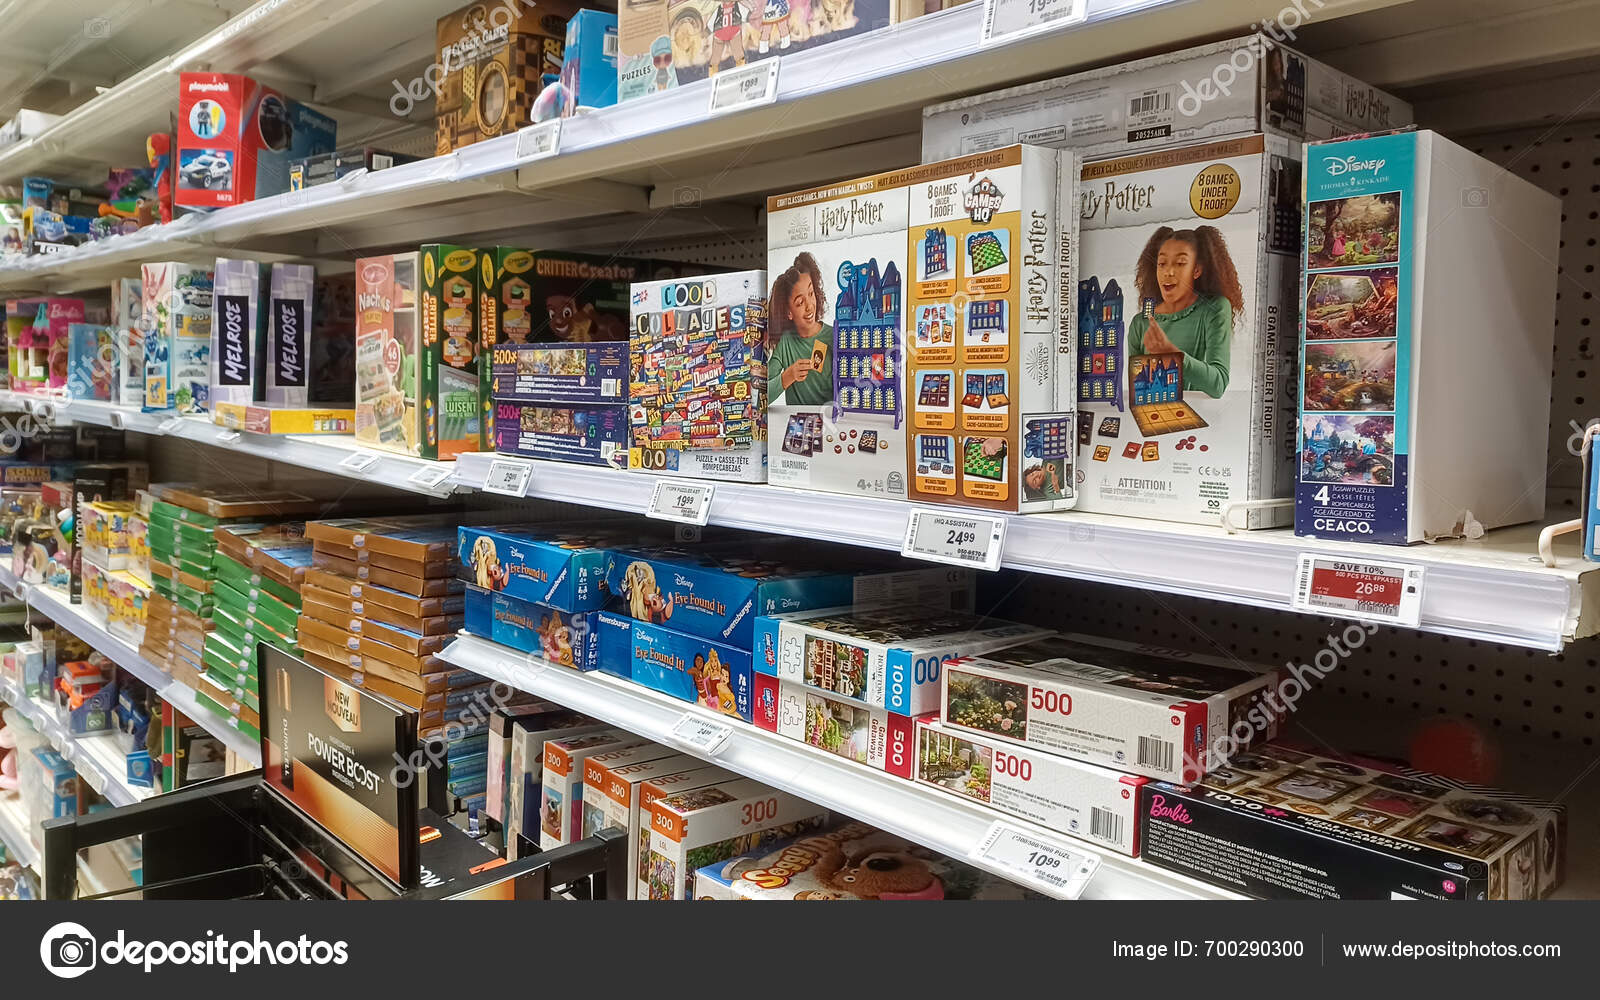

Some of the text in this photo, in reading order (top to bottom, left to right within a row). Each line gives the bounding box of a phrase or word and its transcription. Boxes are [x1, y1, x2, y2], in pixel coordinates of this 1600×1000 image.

[621, 65, 652, 82] PUZZLES
[900, 170, 929, 183] CLASSIQUES
[953, 160, 976, 172] TOUCHES
[1104, 158, 1144, 174] CLASSIQUES
[1199, 173, 1235, 186] 8 GAMES
[928, 183, 958, 199] 8 GAMES
[935, 197, 949, 206] UNDER
[964, 191, 1001, 208] GAMES
[1201, 187, 1228, 198] UNDER
[929, 204, 954, 218] 1 ROOF!
[1103, 181, 1156, 225] Potter
[1204, 198, 1229, 211] ROOF!
[819, 199, 884, 236] Harry Potter
[973, 207, 990, 222] HQ
[1060, 231, 1072, 263] ROOF!
[535, 259, 636, 280] CRITTER Creator
[1024, 209, 1053, 325] Harry Potter
[663, 282, 714, 308] COOL
[1060, 272, 1070, 308] UNDER
[422, 290, 438, 348] CRITTER Creator
[1267, 305, 1278, 314] 8
[488, 297, 497, 345] CRITTER
[1059, 308, 1069, 345] GAMES
[225, 301, 241, 381] MELROSE
[281, 304, 297, 382] MELROSE
[1266, 316, 1277, 357] GAMES
[387, 349, 398, 360] 46
[1059, 345, 1069, 354] 8
[1264, 358, 1275, 397] UNDER
[445, 401, 478, 413] LUISENT
[1263, 405, 1274, 439] ROOF!
[696, 454, 749, 466] PUZZLE CASSE-TÊTE
[702, 463, 742, 473] ROMPECABEZAS
[1118, 477, 1167, 492] ATTENTION
[1313, 485, 1331, 506] 4
[1352, 486, 1376, 494] PUZZLES
[1331, 501, 1376, 510] ROMPECABEZAS
[945, 519, 977, 529] ASSISTANT
[946, 529, 976, 546] 2499
[510, 562, 548, 583] Eye Found It!
[1333, 562, 1385, 575] SAVE 10%
[545, 567, 568, 602] Ravensburger
[1355, 581, 1385, 595] 2688
[674, 591, 688, 605] Eye
[689, 593, 716, 612] Found
[717, 600, 727, 617] It!
[598, 614, 631, 630] Ravensburger
[722, 599, 753, 639] Ravensburger
[635, 646, 649, 660] Eye
[650, 648, 675, 667] Found
[675, 656, 685, 672] It!
[875, 654, 885, 705] HOMETOWN
[891, 664, 904, 708] 1000
[334, 690, 350, 708] NEW
[1031, 687, 1073, 716] 500
[327, 700, 359, 727] NOUVEAU
[869, 719, 878, 761] Getaways
[877, 726, 886, 758] Garden
[892, 730, 905, 767] 500
[308, 732, 345, 773] POWER
[346, 760, 380, 795] BOOST
[547, 752, 561, 768] 300
[995, 751, 1032, 782] 500
[587, 768, 602, 784] 300
[610, 782, 625, 798] 300
[1205, 790, 1263, 810] 1000
[742, 798, 778, 826] 300
[1150, 794, 1193, 824] Barbie
[655, 813, 673, 830] 300
[741, 843, 821, 890] Soggy
[1028, 851, 1061, 868] 1099
